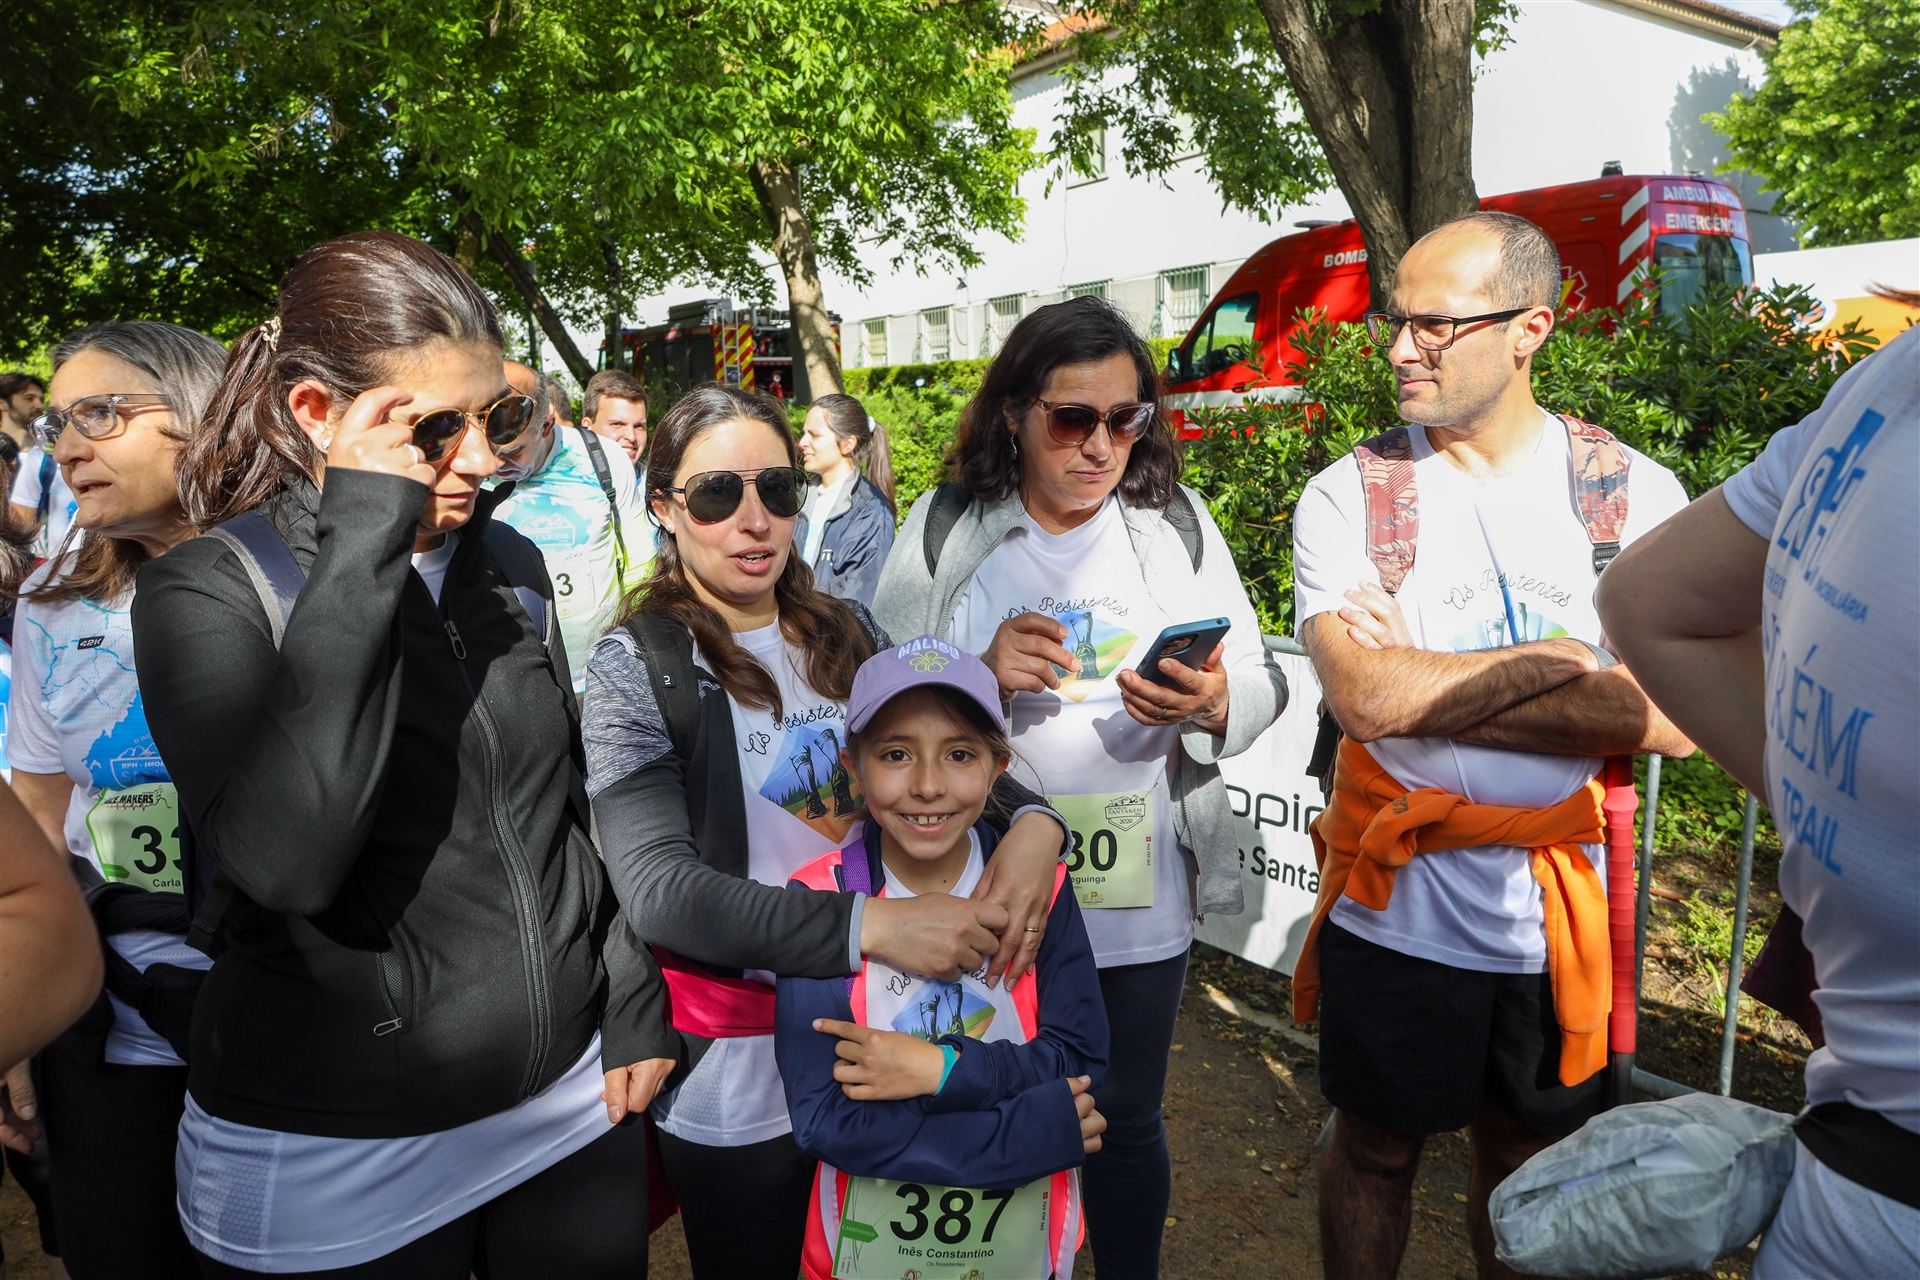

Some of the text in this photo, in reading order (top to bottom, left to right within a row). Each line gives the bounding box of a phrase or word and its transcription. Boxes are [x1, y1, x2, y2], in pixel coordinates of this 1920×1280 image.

[1665, 213, 1744, 235] EMERGÊNCIA
[1323, 248, 1368, 268] BOMB
[1443, 584, 1474, 610] Os
[898, 638, 960, 660] MALIBU
[744, 731, 771, 756] Os
[119, 794, 154, 804] MAKERS
[1782, 776, 1843, 876] TRAIL
[1250, 846, 1320, 894] Santa
[152, 879, 181, 888] Carla
[889, 1183, 1015, 1245] 387
[842, 1224, 875, 1238] CAMINHADA
[898, 1245, 994, 1259] Inês Constantino
